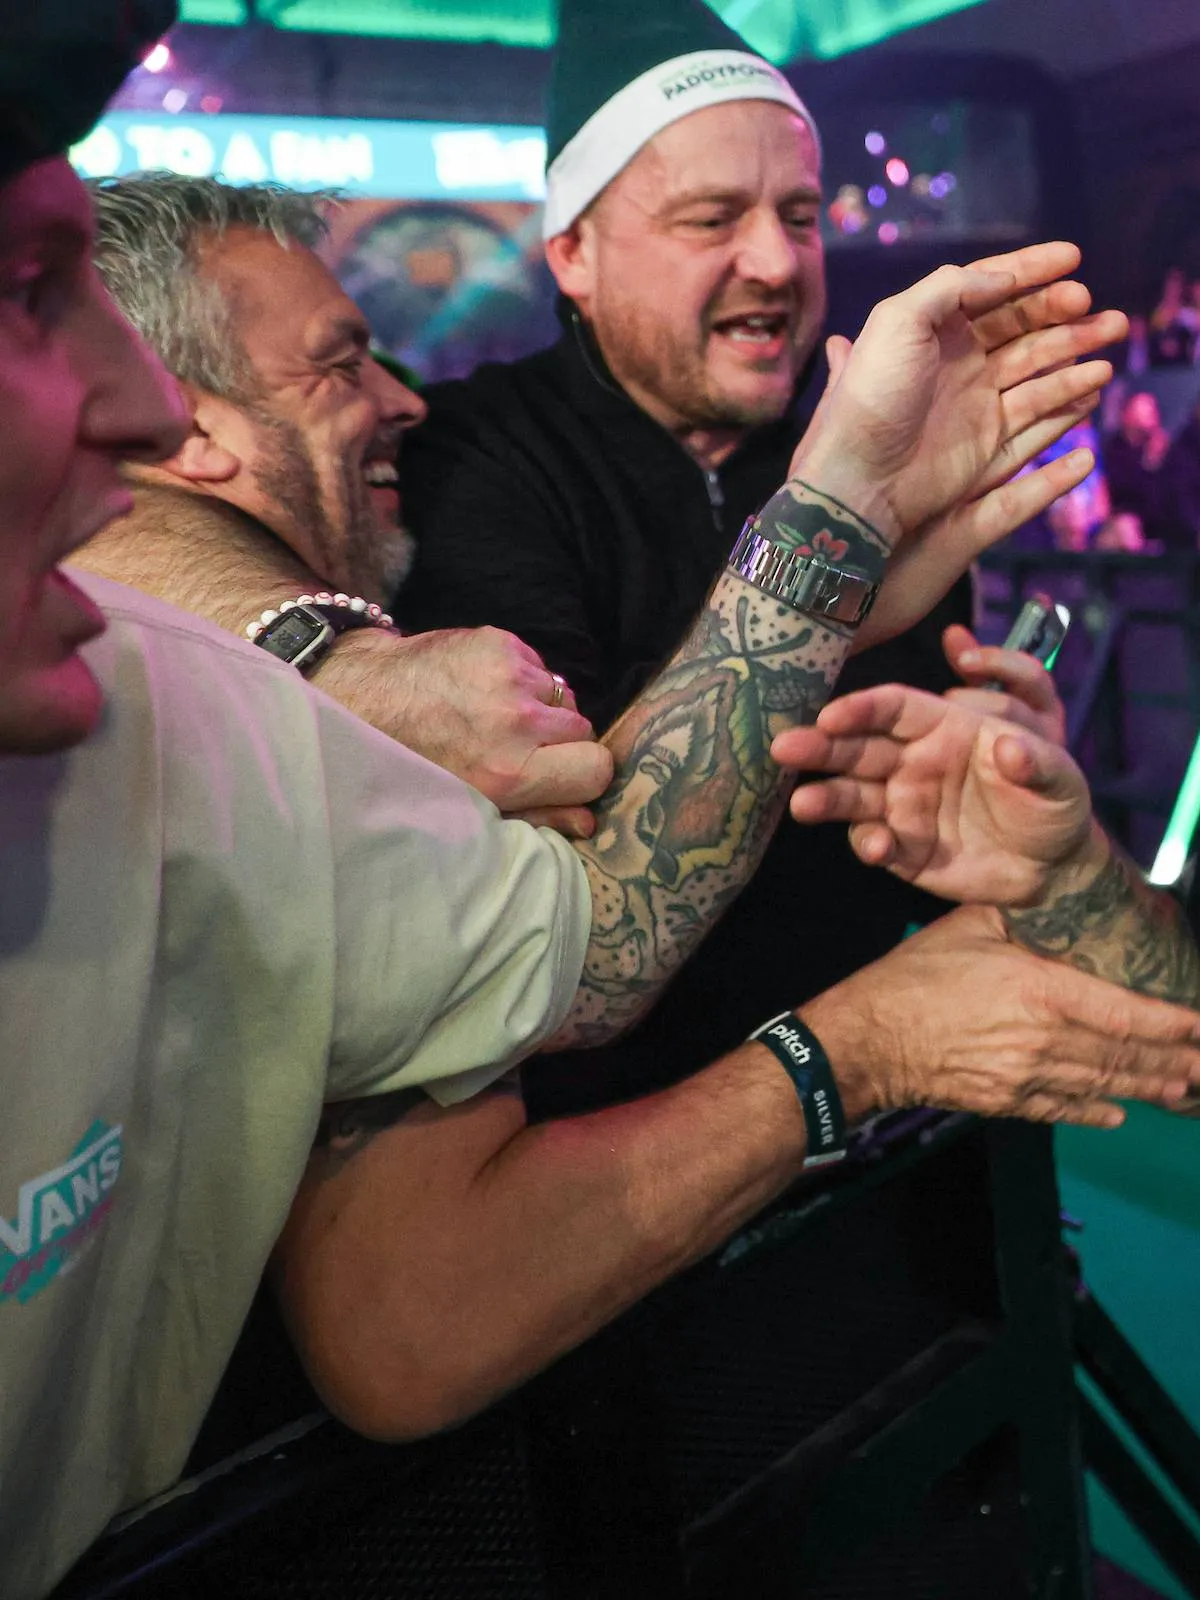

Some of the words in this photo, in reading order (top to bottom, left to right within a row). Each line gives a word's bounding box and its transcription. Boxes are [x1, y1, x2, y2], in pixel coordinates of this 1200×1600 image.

[768, 1024, 811, 1065] pitch
[813, 1089, 835, 1146] SILVER
[0, 1123, 124, 1256] VANS
